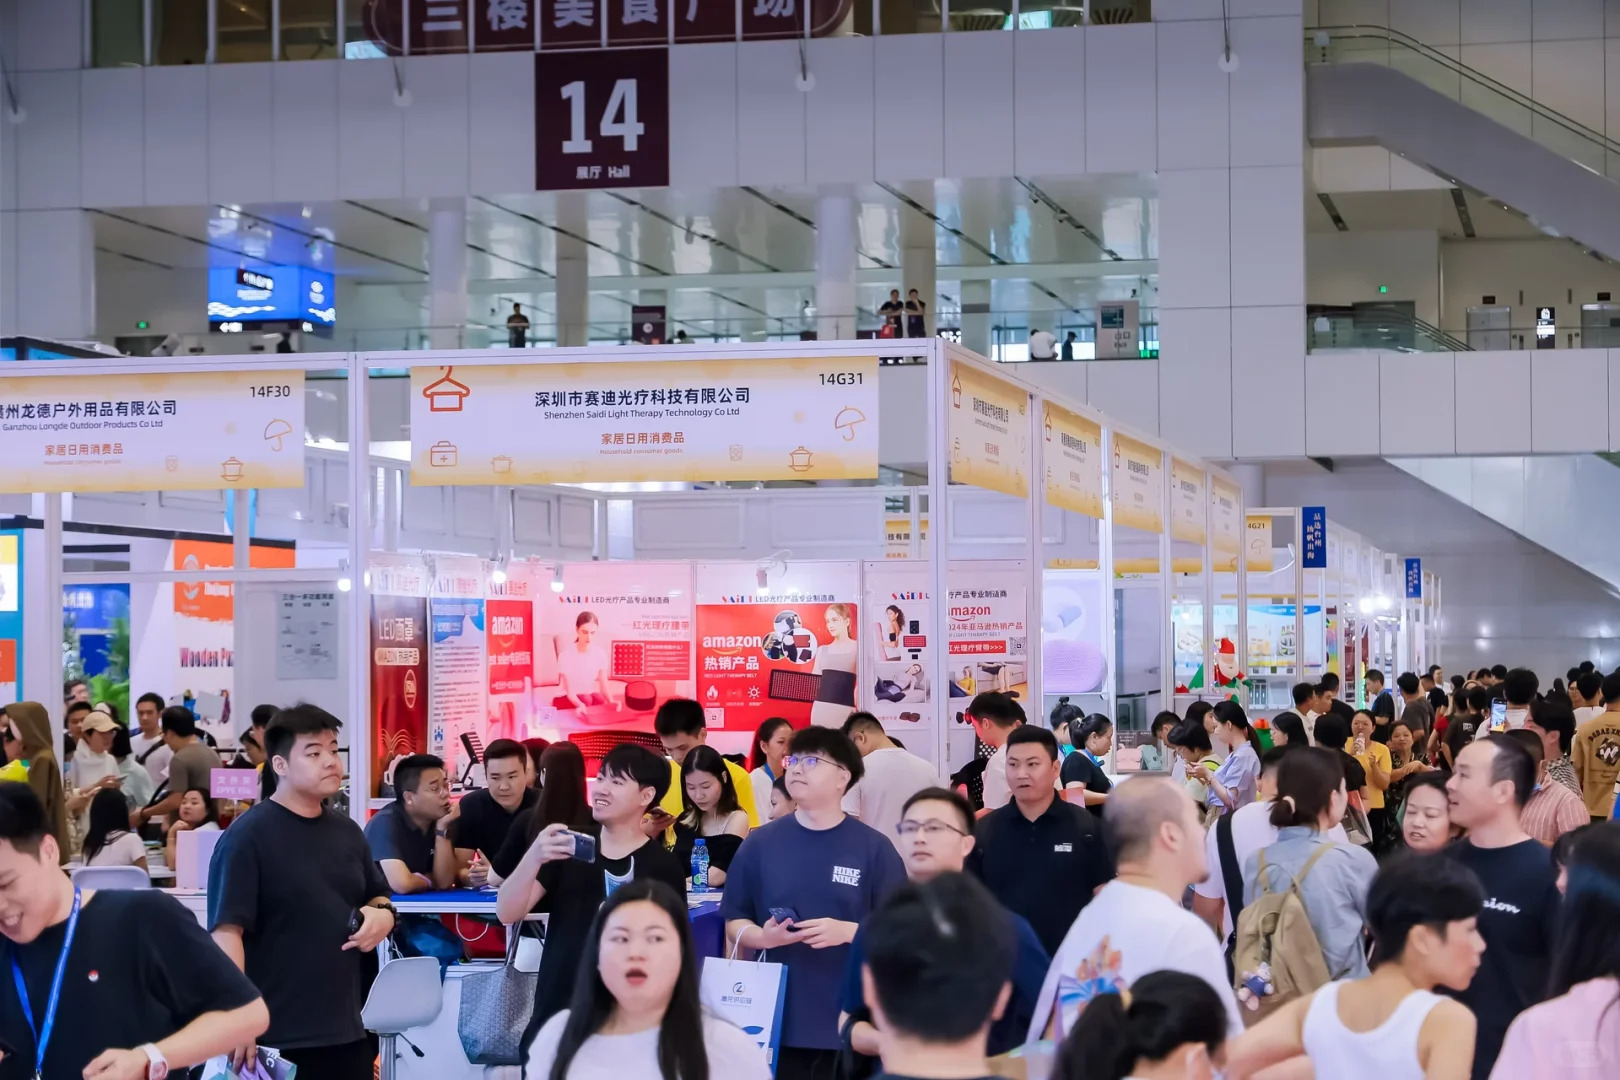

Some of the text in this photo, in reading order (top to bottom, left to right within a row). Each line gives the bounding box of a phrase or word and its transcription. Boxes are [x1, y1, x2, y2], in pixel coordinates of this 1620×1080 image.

[561, 79, 645, 153] 14
[576, 165, 631, 179] 展厅 Hall
[818, 372, 865, 386] 14G31
[249, 385, 291, 398] 14F30
[534, 387, 750, 408] 深圳市赛迪光疗科技有限公司
[544, 407, 740, 420] Shenzhen Saidi Light Therapy Technology Co Ltd
[2, 419, 163, 432] Ganzhou Longde Outdoor Products Co Ltd
[601, 432, 685, 445] 家居日用消费品
[45, 443, 123, 456] 家居日用消费品
[948, 606, 991, 616] mazon
[492, 615, 524, 636] amazon
[702, 635, 762, 648] amazon
[179, 647, 218, 668] Wooden
[704, 655, 760, 671] 热销产品
[833, 865, 861, 878] HIKE
[832, 873, 859, 887] NIKE
